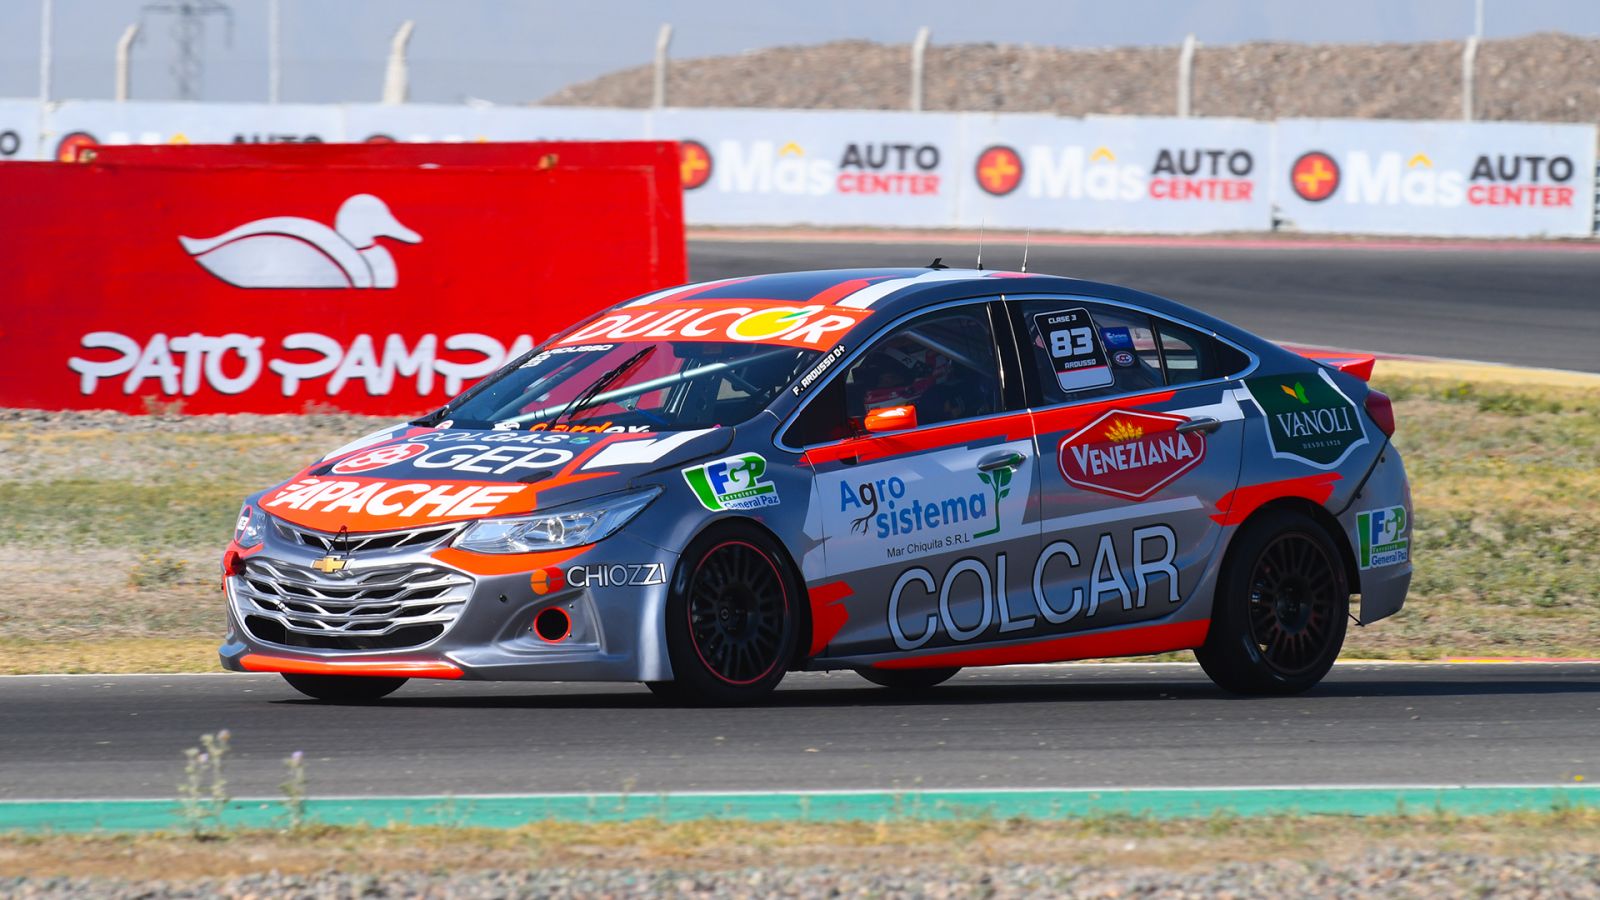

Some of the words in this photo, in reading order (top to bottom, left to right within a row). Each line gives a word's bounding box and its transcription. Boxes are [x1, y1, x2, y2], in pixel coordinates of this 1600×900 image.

[839, 143, 941, 171] AUTO
[1151, 149, 1254, 176] AUTO
[1470, 155, 1575, 182] AUTO
[836, 173, 942, 195] CENTER
[1148, 179, 1254, 201] CENTER
[1467, 185, 1574, 206] CENTER
[557, 305, 856, 344] DULCOR
[1048, 315, 1070, 324] CLASE
[1050, 326, 1094, 358] 83
[67, 331, 266, 396] PATO
[1276, 406, 1353, 438] VANOLI
[408, 432, 571, 445] COLGAS
[413, 445, 574, 474] GEP
[1070, 432, 1195, 476] VENEZIANA
[707, 455, 766, 495] FGP
[266, 479, 529, 518] APACHE
[760, 495, 779, 505] Paz
[840, 476, 906, 522] Agro
[876, 492, 987, 539] sistema
[1372, 507, 1406, 545] FGP
[887, 547, 905, 558] Mar
[907, 539, 943, 554] Chiquita
[1371, 551, 1397, 566] General
[566, 563, 667, 587] CHIOZZI
[887, 522, 1182, 651] COLCAR
